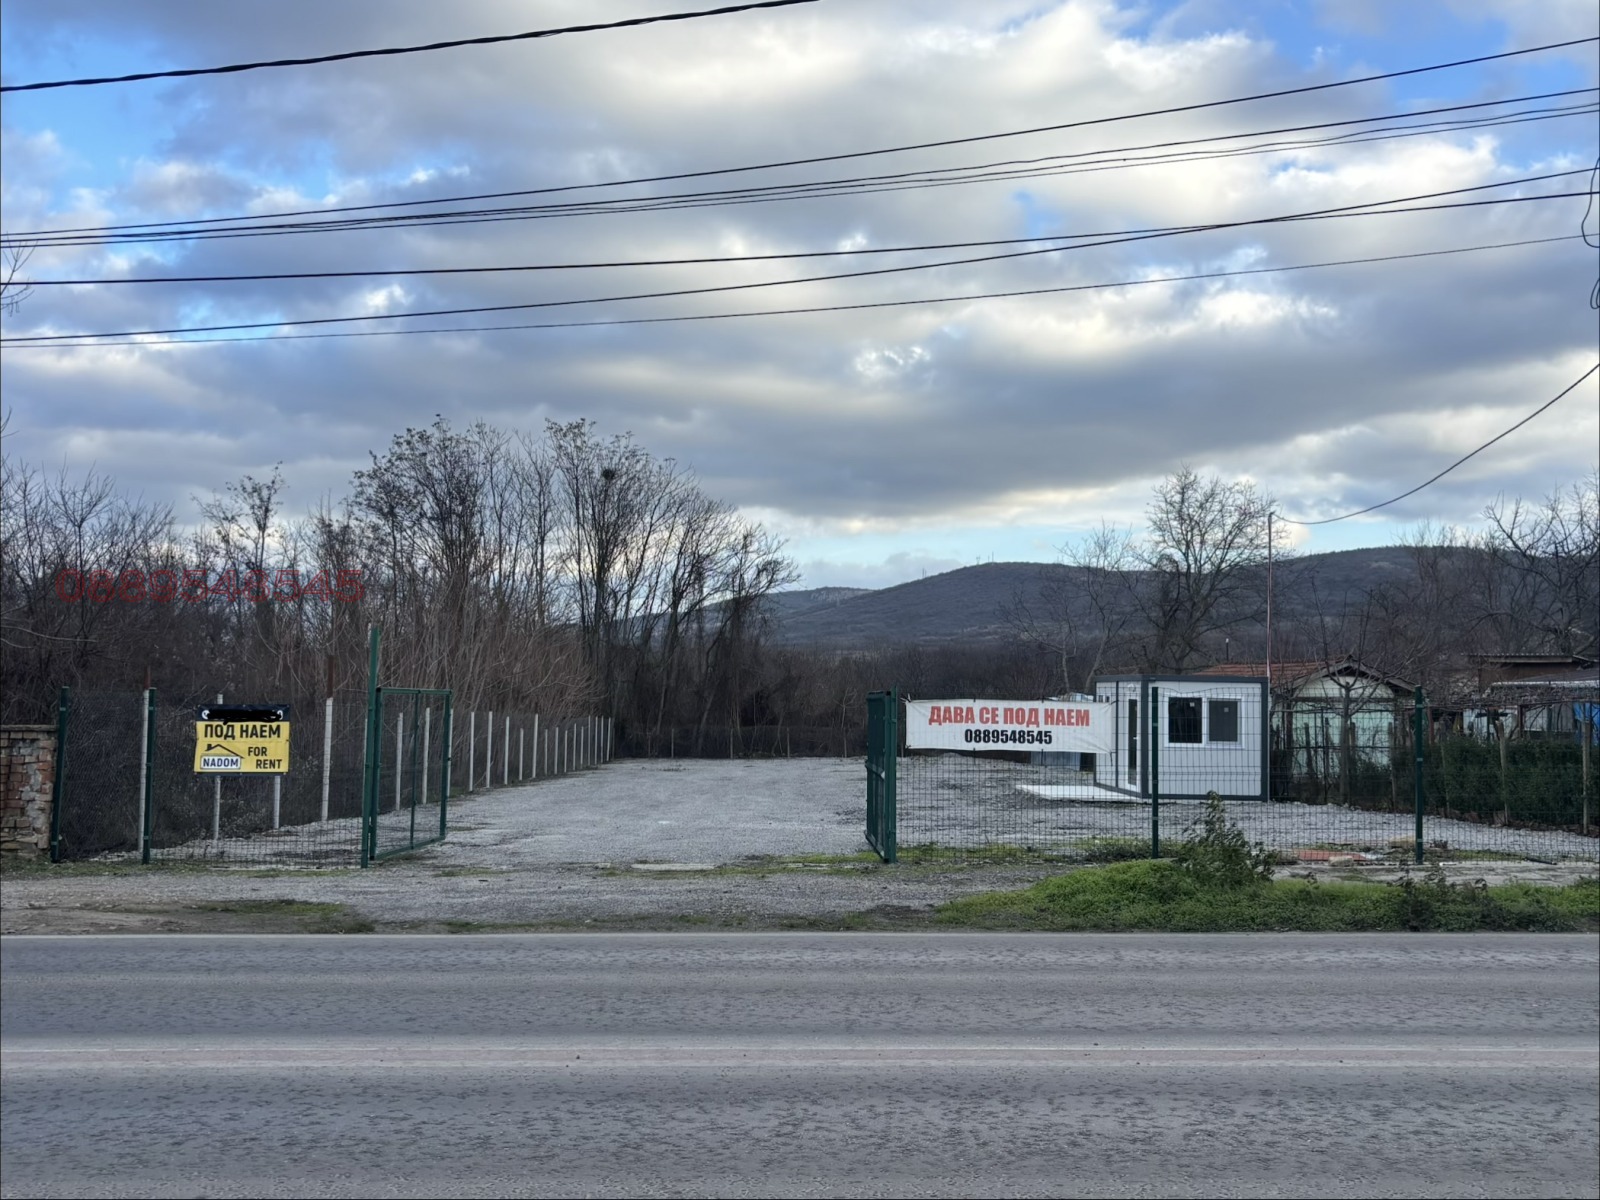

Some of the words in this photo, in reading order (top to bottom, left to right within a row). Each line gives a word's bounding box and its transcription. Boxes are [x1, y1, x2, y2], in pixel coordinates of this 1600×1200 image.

[928, 705, 976, 726] ДАВА
[979, 706, 1000, 725] СЕ
[1003, 707, 1040, 728] ПОД
[1044, 708, 1090, 727] НАЕМ
[204, 724, 236, 741] ПОД
[239, 724, 281, 739] НАЕМ
[964, 728, 1053, 745] 0889548545
[247, 746, 268, 757] FOR
[202, 757, 239, 768] NADOM
[255, 758, 283, 770] RENT
